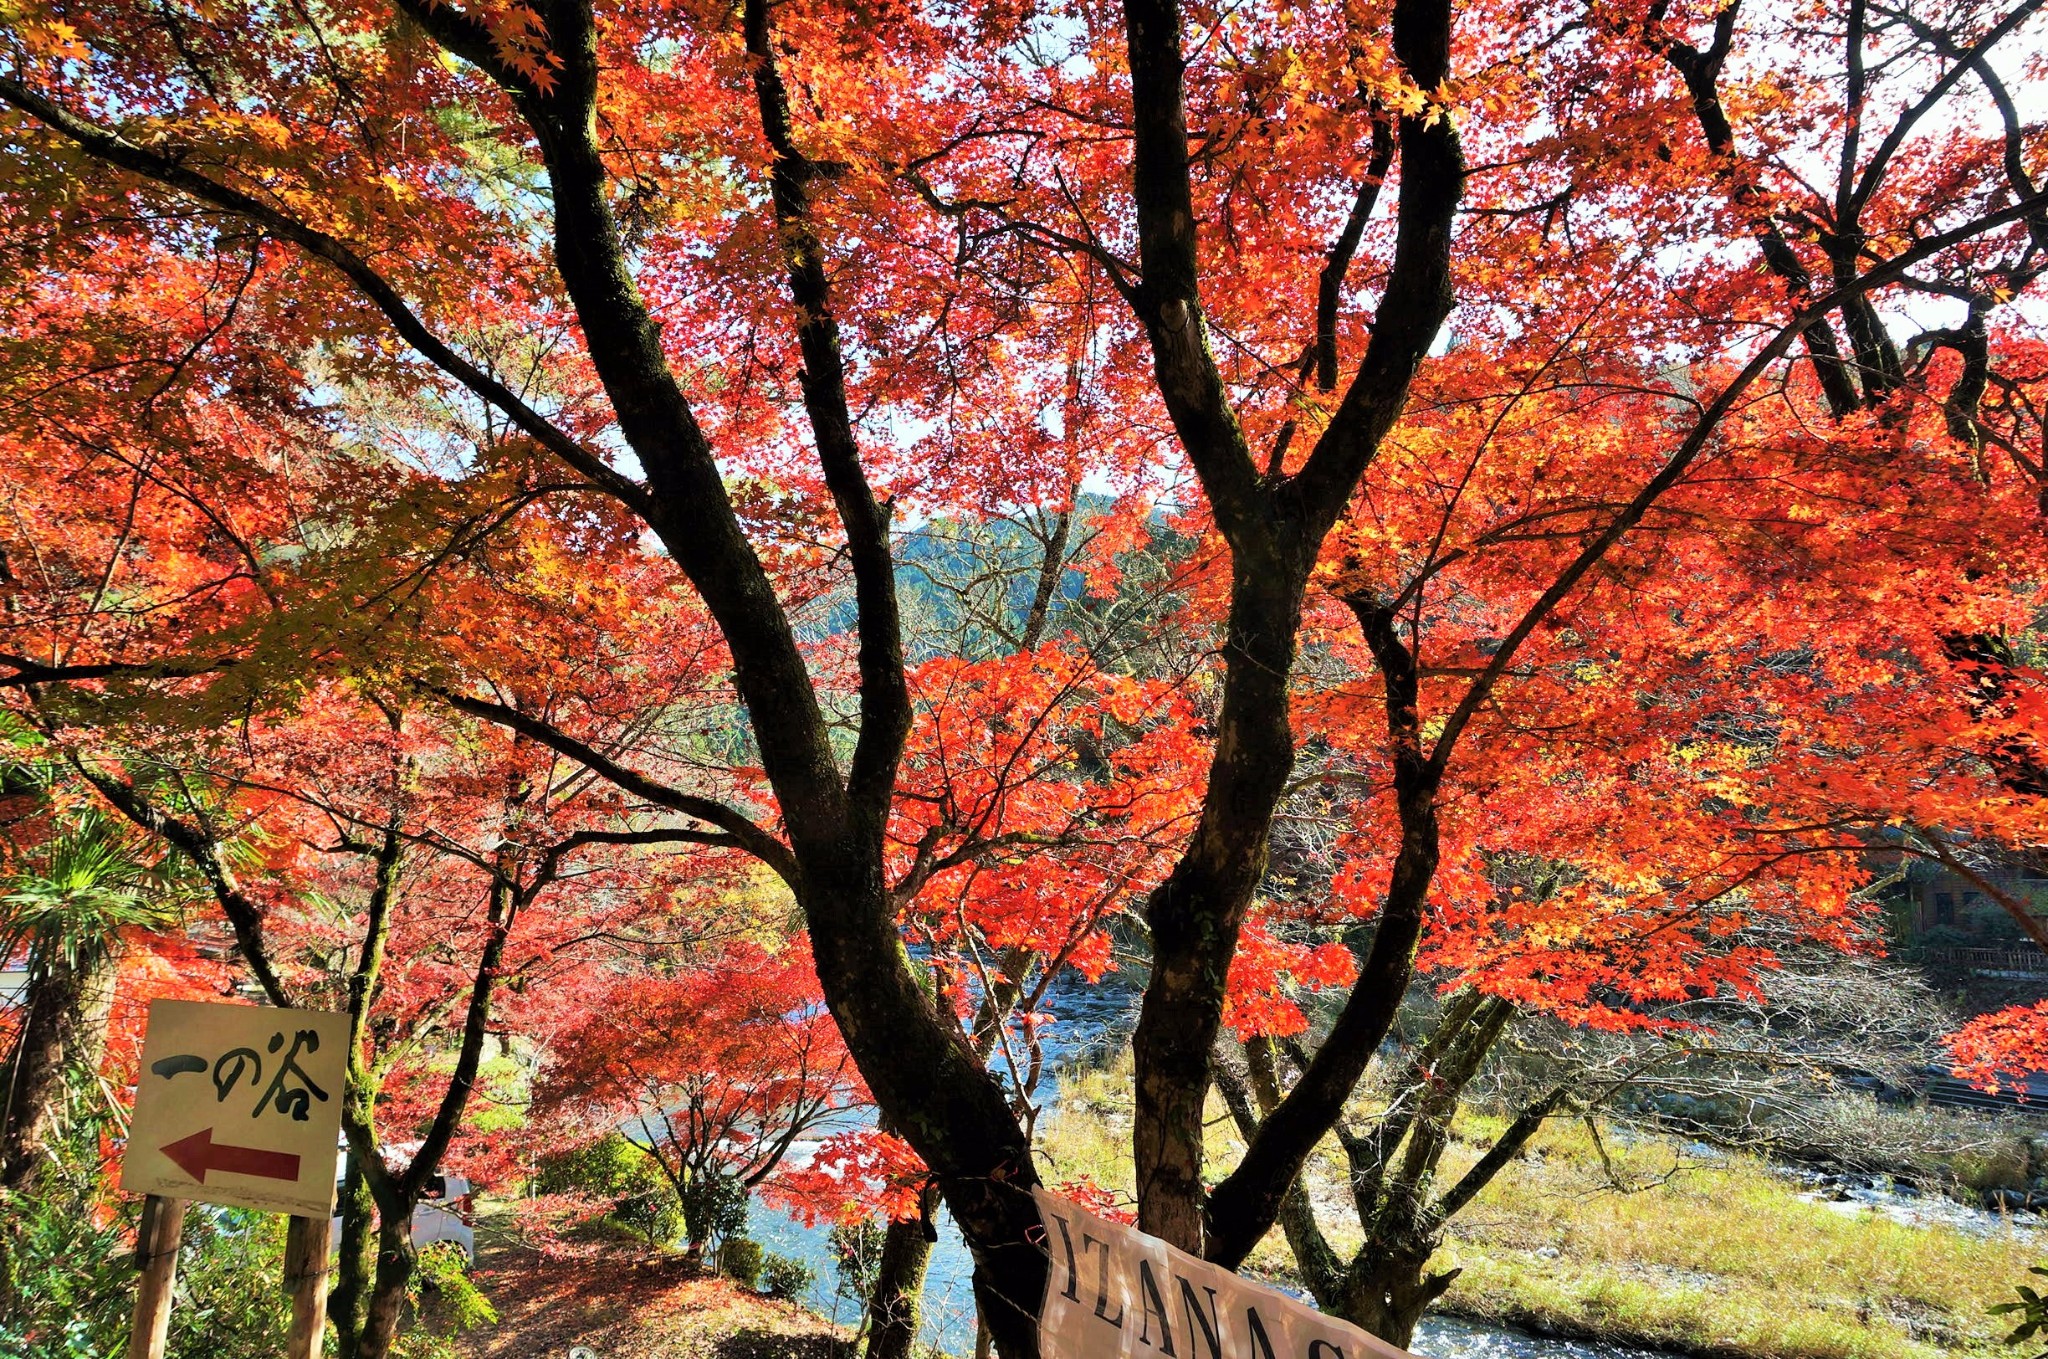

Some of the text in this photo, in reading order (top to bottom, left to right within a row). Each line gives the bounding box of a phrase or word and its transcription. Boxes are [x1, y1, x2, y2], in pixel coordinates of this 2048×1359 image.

[151, 1029, 329, 1121] 一の谷
[1050, 1213, 1345, 1359] IZANA
